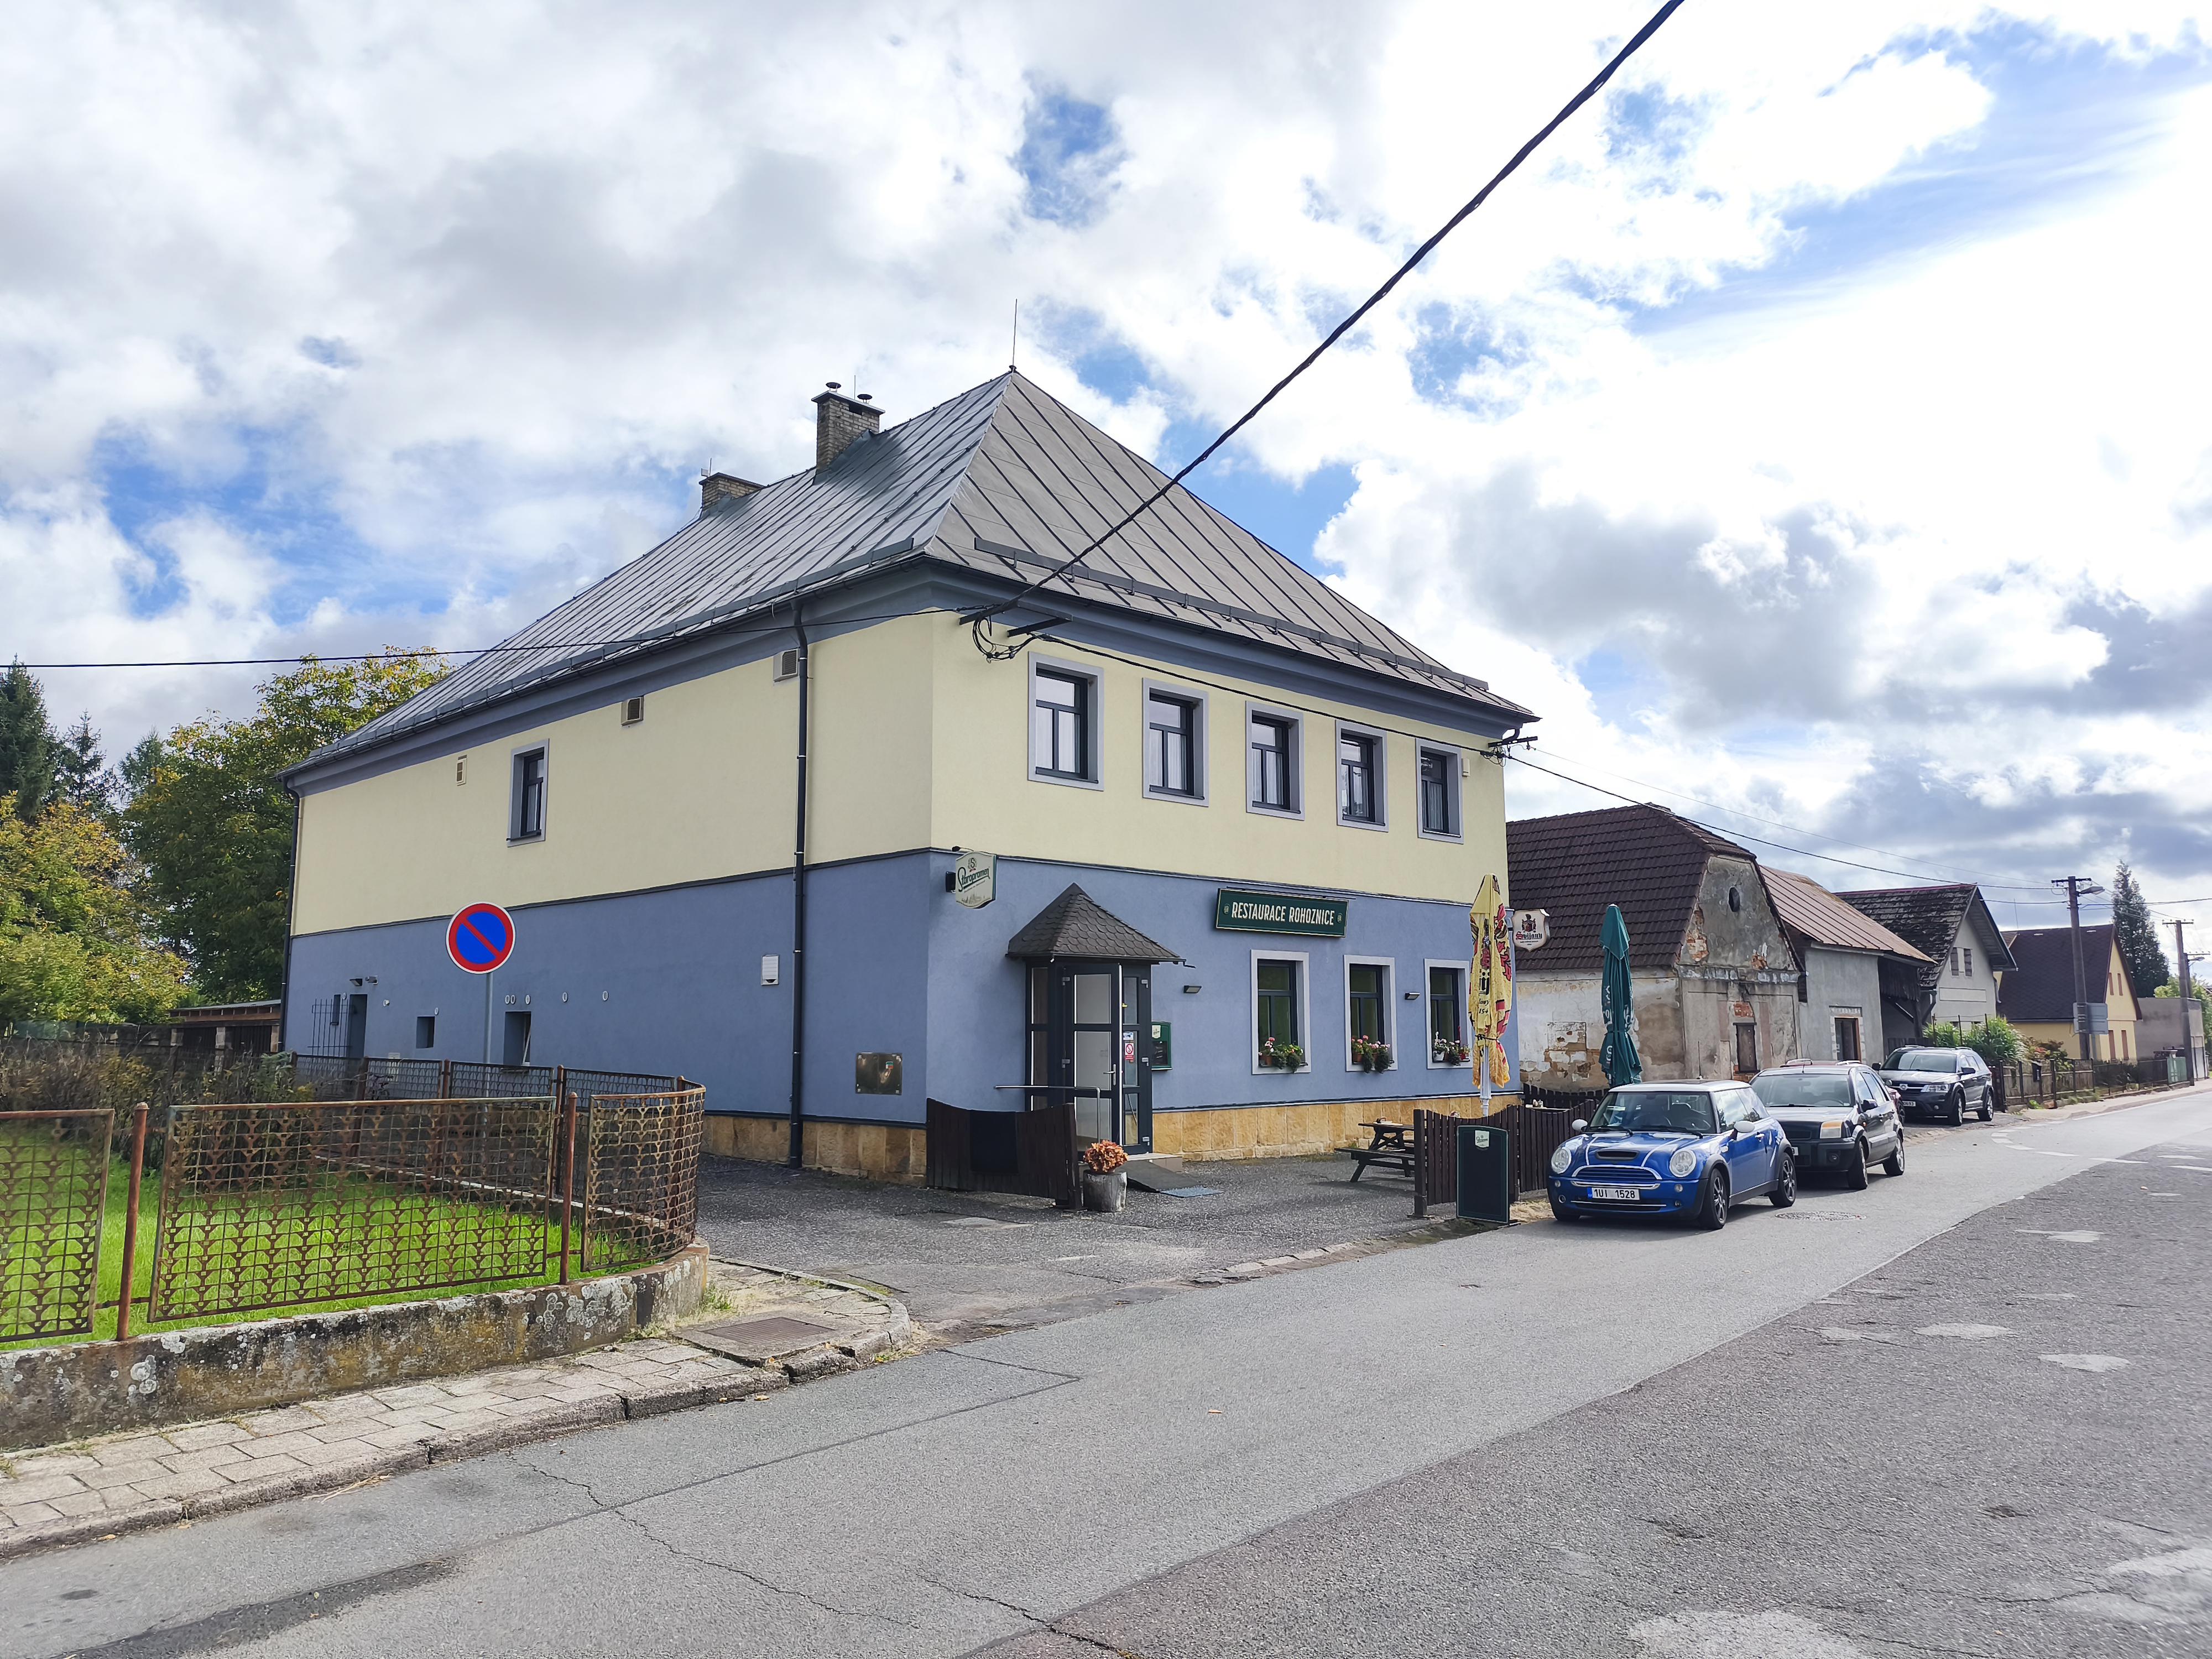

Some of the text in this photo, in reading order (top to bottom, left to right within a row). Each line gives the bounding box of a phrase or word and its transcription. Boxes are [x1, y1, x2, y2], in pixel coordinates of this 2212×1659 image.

[958, 867, 990, 892] Staropramen
[1232, 901, 1335, 925] RESTAURACE ROHOZNICE
[1516, 931, 1542, 940] Svijany
[1594, 1189, 1608, 1198] 1UI
[1615, 1190, 1635, 1199] 1528
